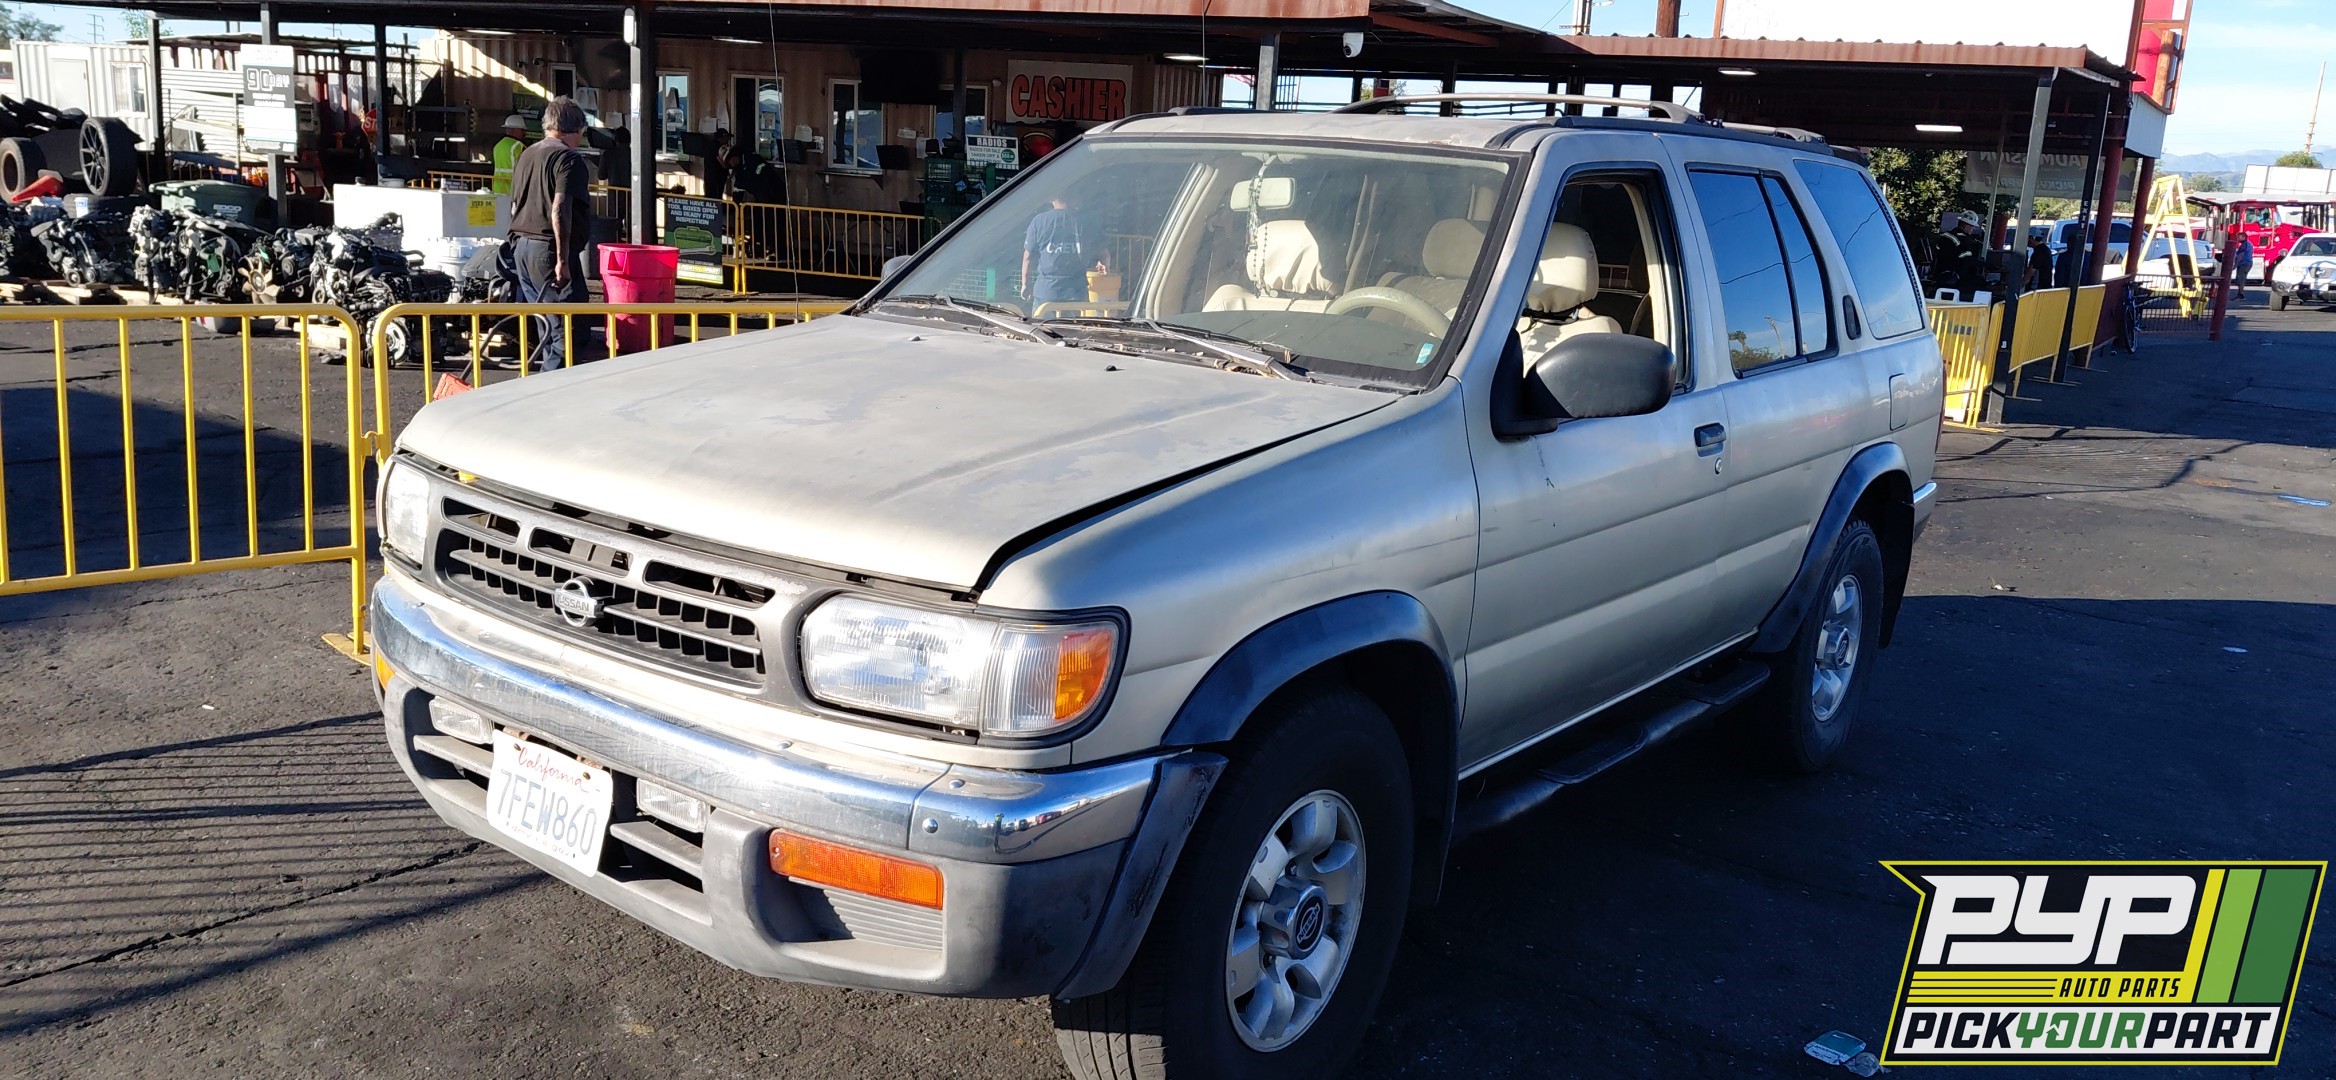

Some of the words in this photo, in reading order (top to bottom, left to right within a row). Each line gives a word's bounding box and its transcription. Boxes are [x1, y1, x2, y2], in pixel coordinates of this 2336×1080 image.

[246, 68, 273, 91] 90
[1011, 74, 1126, 122] CASHIER
[977, 137, 1007, 148] RADIOS
[675, 216, 710, 225] INSPECTION
[682, 205, 701, 213] BOXES
[2080, 200, 2089, 229] EXIT
[557, 593, 590, 612] NISSAN
[518, 747, 590, 793] California
[497, 768, 598, 855] 7FEW860
[1298, 905, 1320, 941] NISSAN
